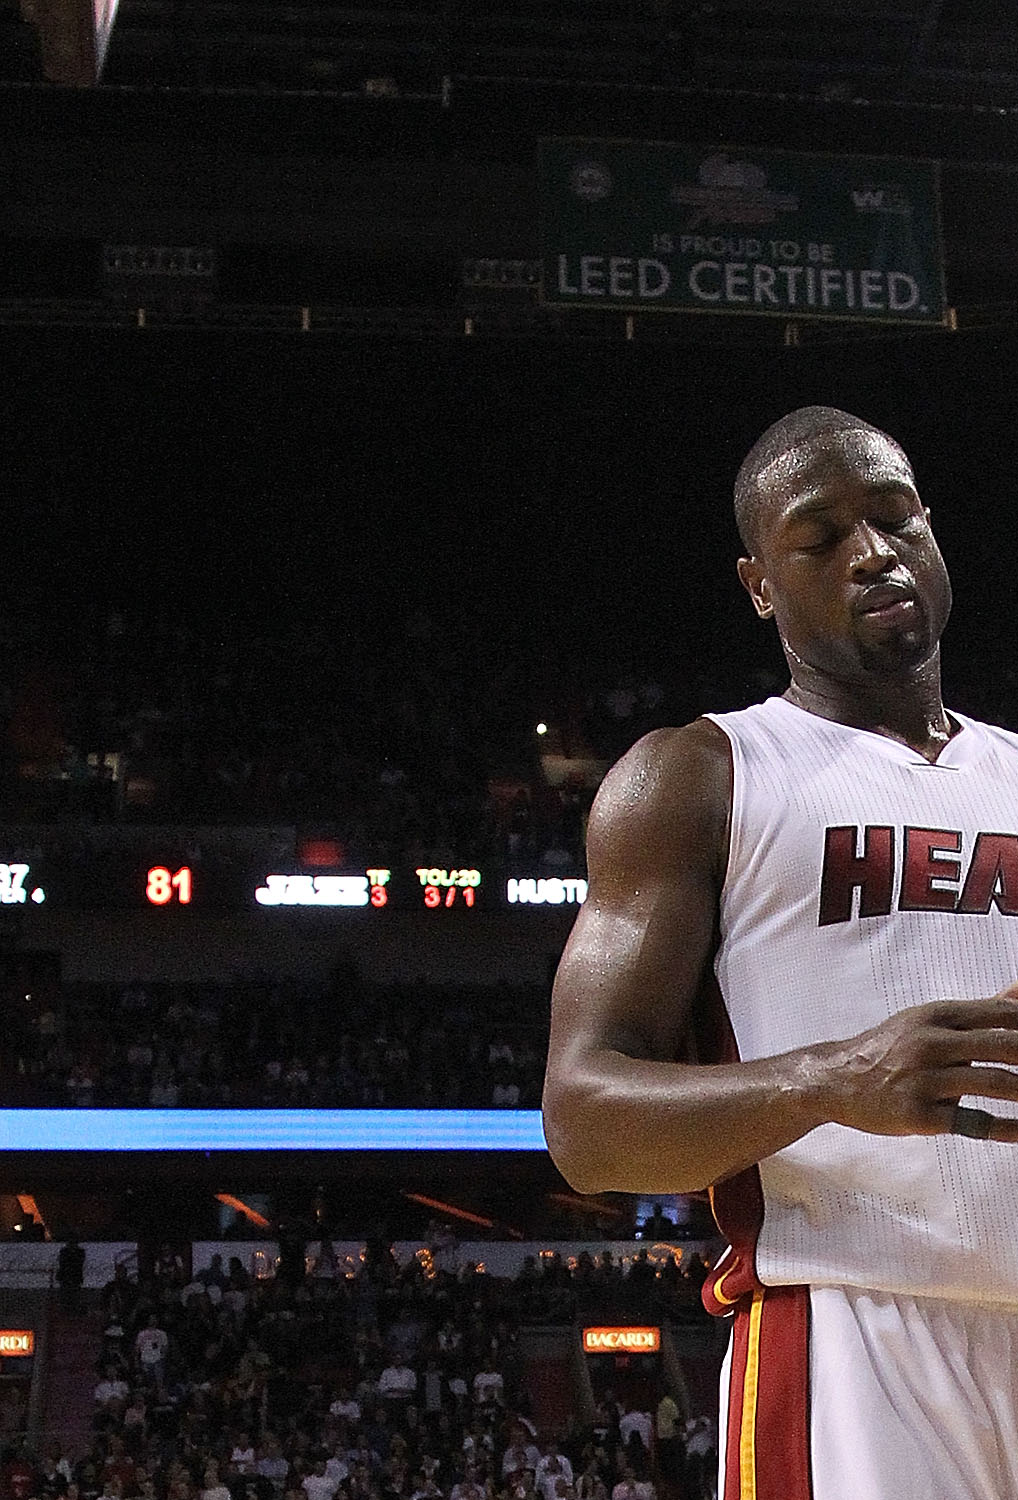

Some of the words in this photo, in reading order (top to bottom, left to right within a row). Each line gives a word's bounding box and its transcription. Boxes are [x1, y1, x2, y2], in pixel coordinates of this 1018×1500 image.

[680, 234, 760, 258] PROUD
[771, 240, 800, 260] TO
[808, 243, 835, 262] BE
[558, 253, 671, 298] LEED
[688, 260, 929, 313] CERTIFIED.
[146, 865, 194, 905] 81
[370, 885, 388, 908] 3
[586, 1332, 655, 1348] BACARDI
